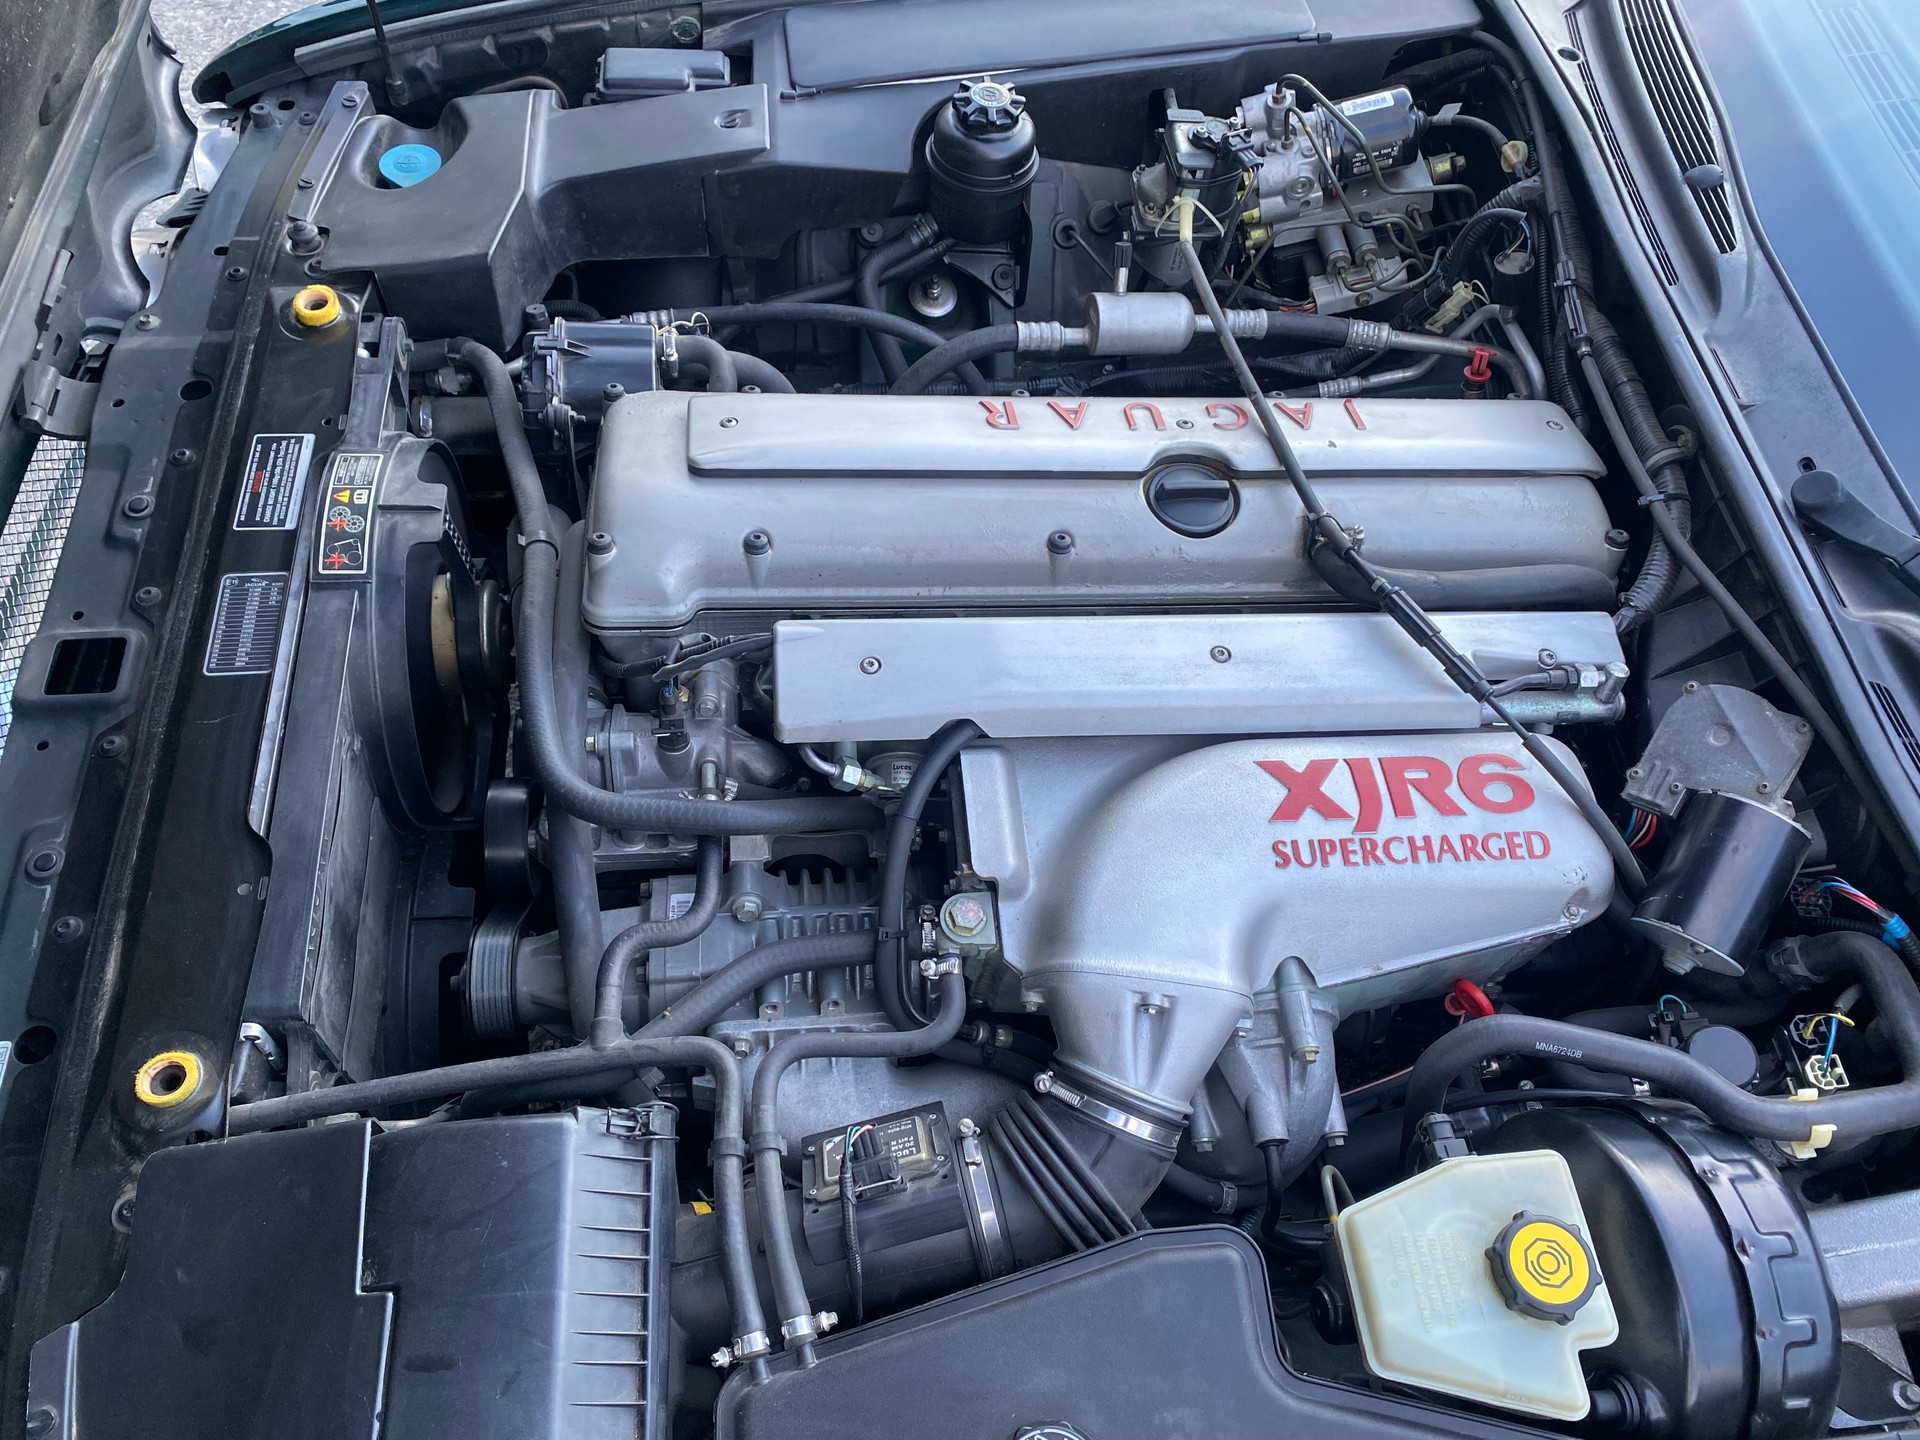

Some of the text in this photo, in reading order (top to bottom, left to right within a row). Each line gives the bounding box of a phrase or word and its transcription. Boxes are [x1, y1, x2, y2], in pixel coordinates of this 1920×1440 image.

[979, 399, 1366, 430] JAGUAR
[1253, 753, 1535, 834] XJR6
[1271, 830, 1551, 868] SUPERCHARGED
